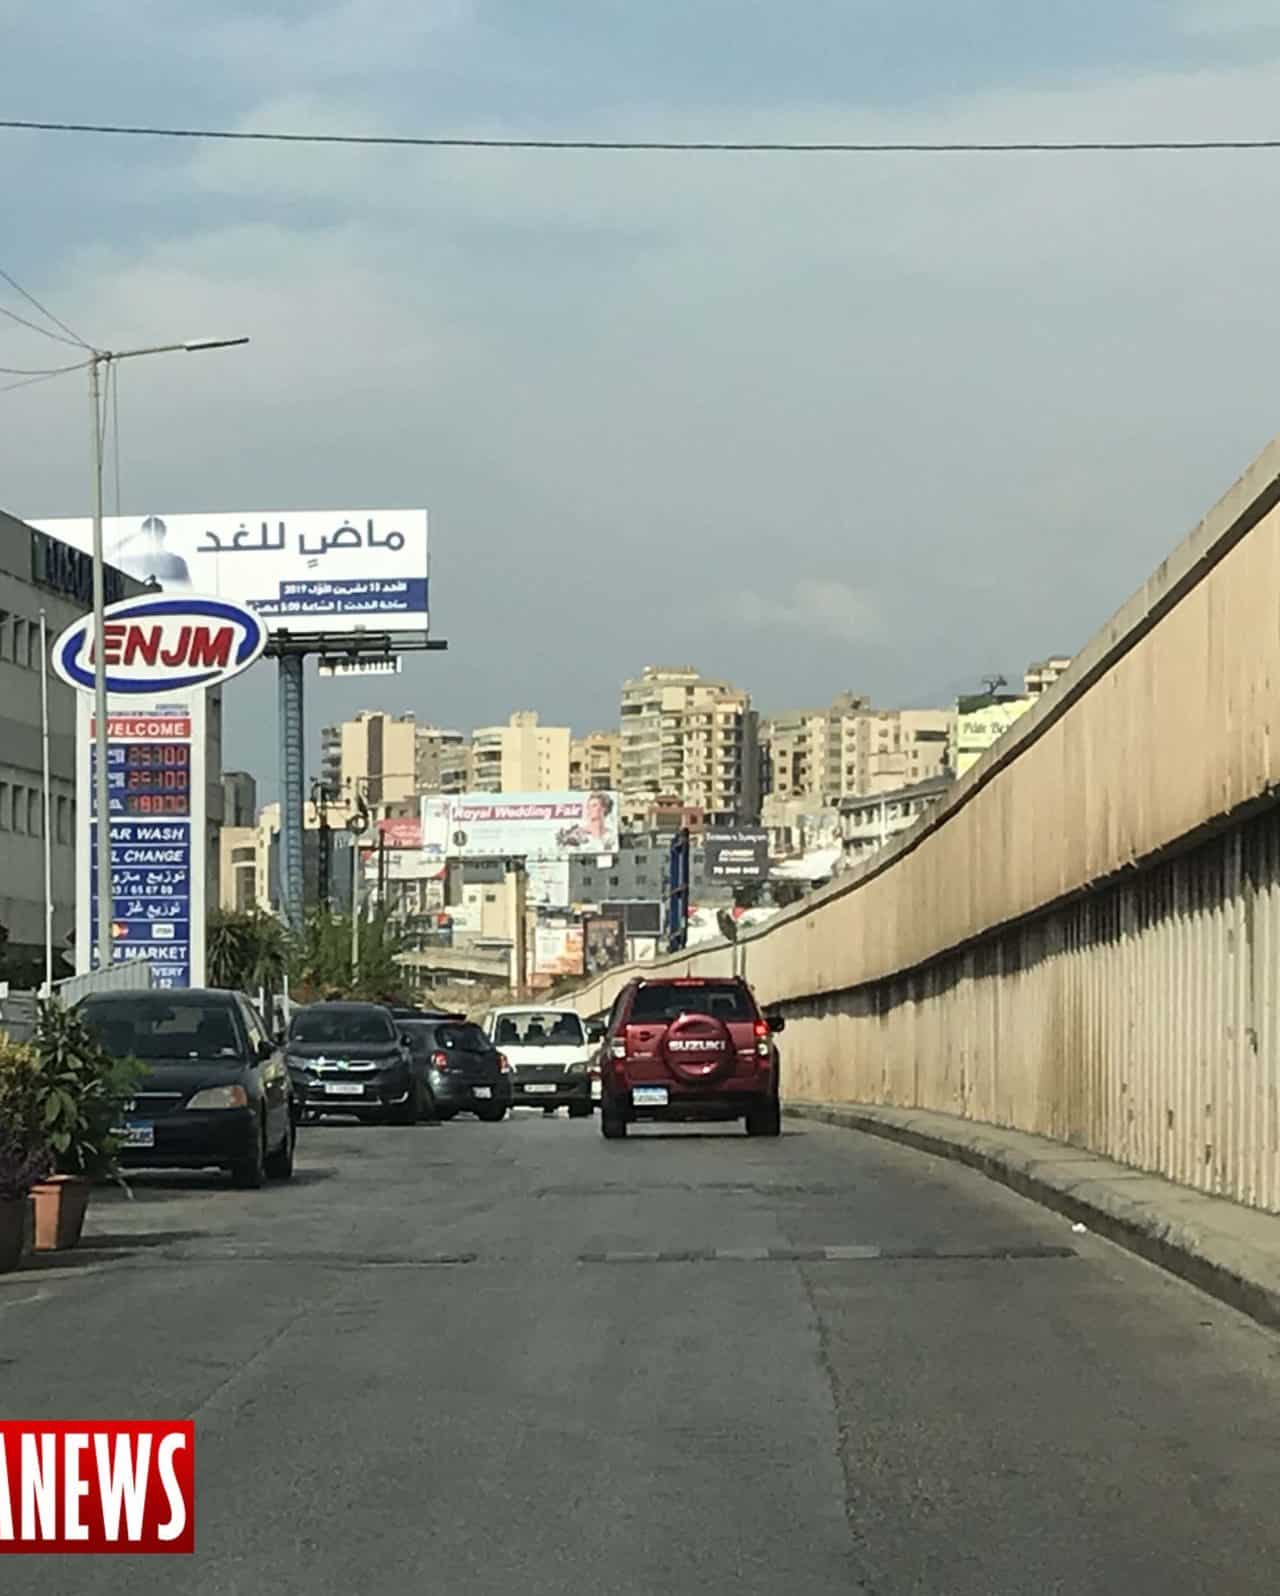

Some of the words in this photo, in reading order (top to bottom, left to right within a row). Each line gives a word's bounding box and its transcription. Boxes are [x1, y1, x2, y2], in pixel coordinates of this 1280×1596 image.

[197, 522, 284, 552] للغد
[89, 625, 235, 668] ENJM
[109, 828, 132, 841] AR
[136, 827, 185, 841] WASH
[123, 849, 185, 863] CHANGE
[124, 946, 187, 960] MARKET
[668, 1039, 727, 1051] SUZUKI
